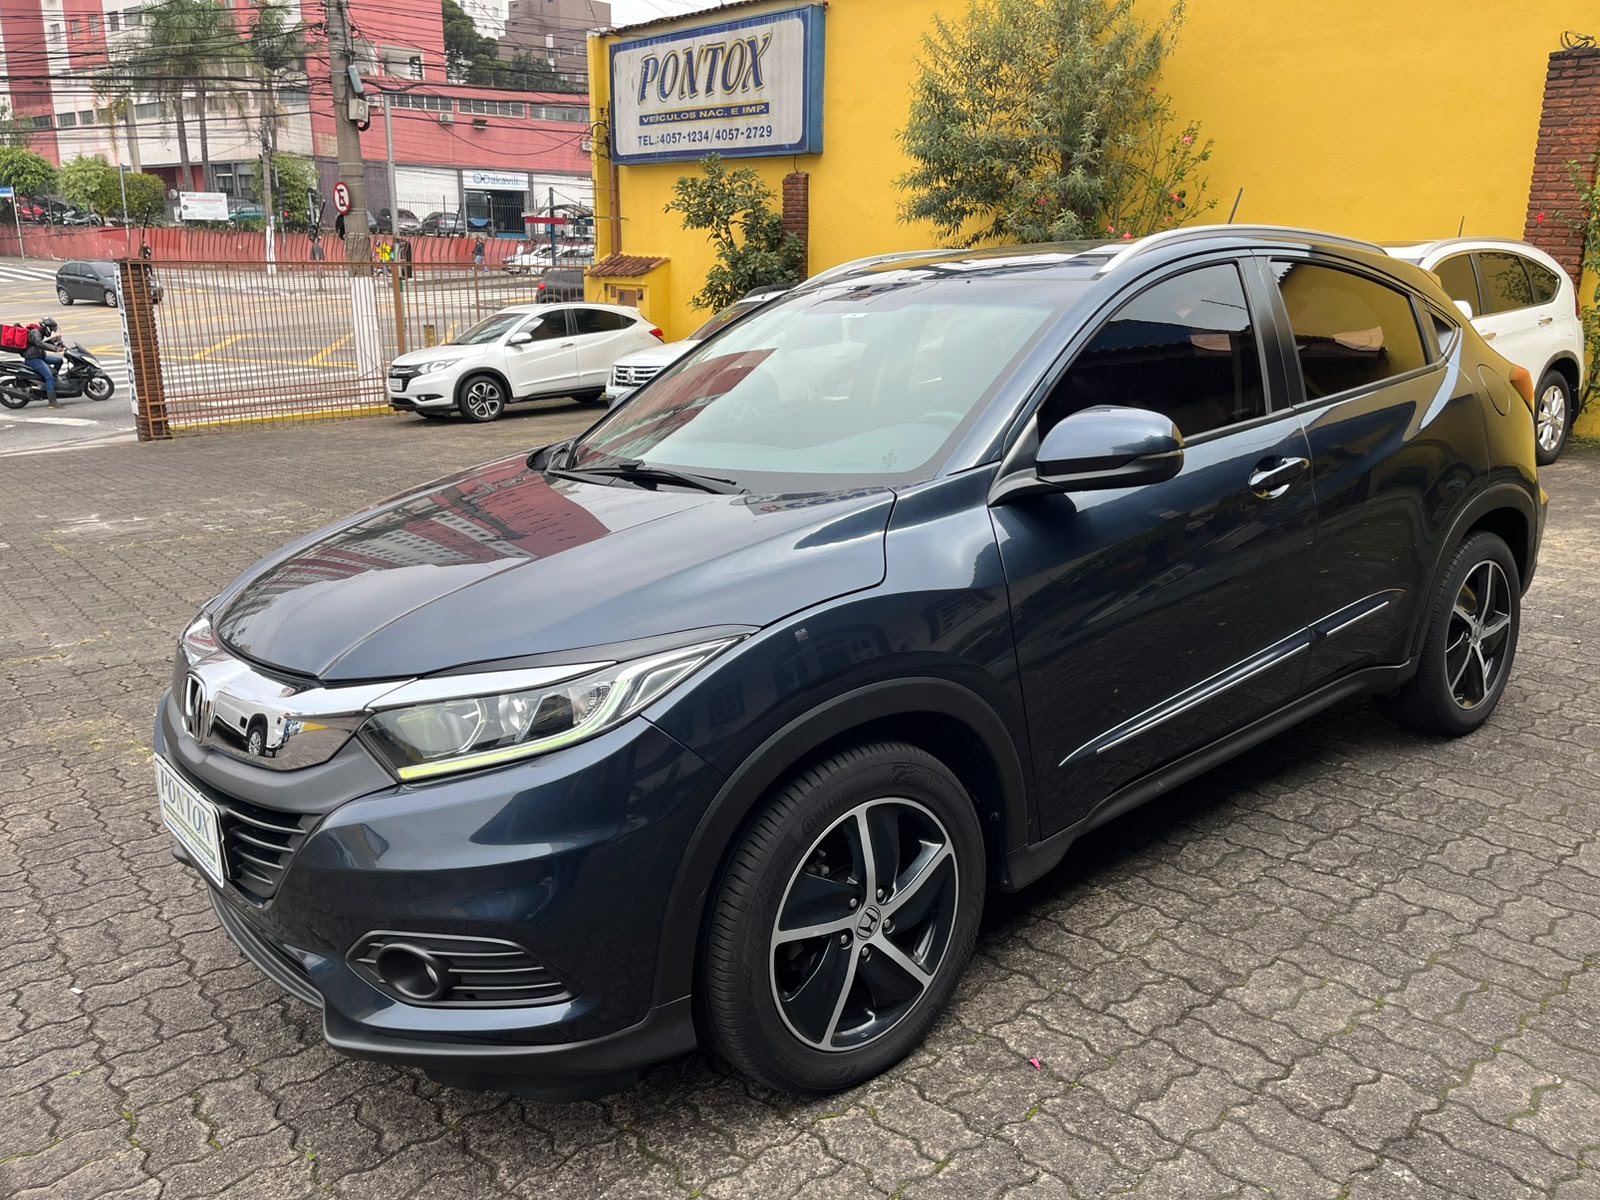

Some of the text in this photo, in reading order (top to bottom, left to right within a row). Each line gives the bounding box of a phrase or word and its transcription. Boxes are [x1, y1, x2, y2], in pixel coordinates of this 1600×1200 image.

[638, 32, 773, 105] PONTOX
[699, 109, 728, 118] NAC.
[730, 107, 739, 115] E
[742, 104, 767, 114] IMP.
[160, 770, 213, 843] PONTOX
